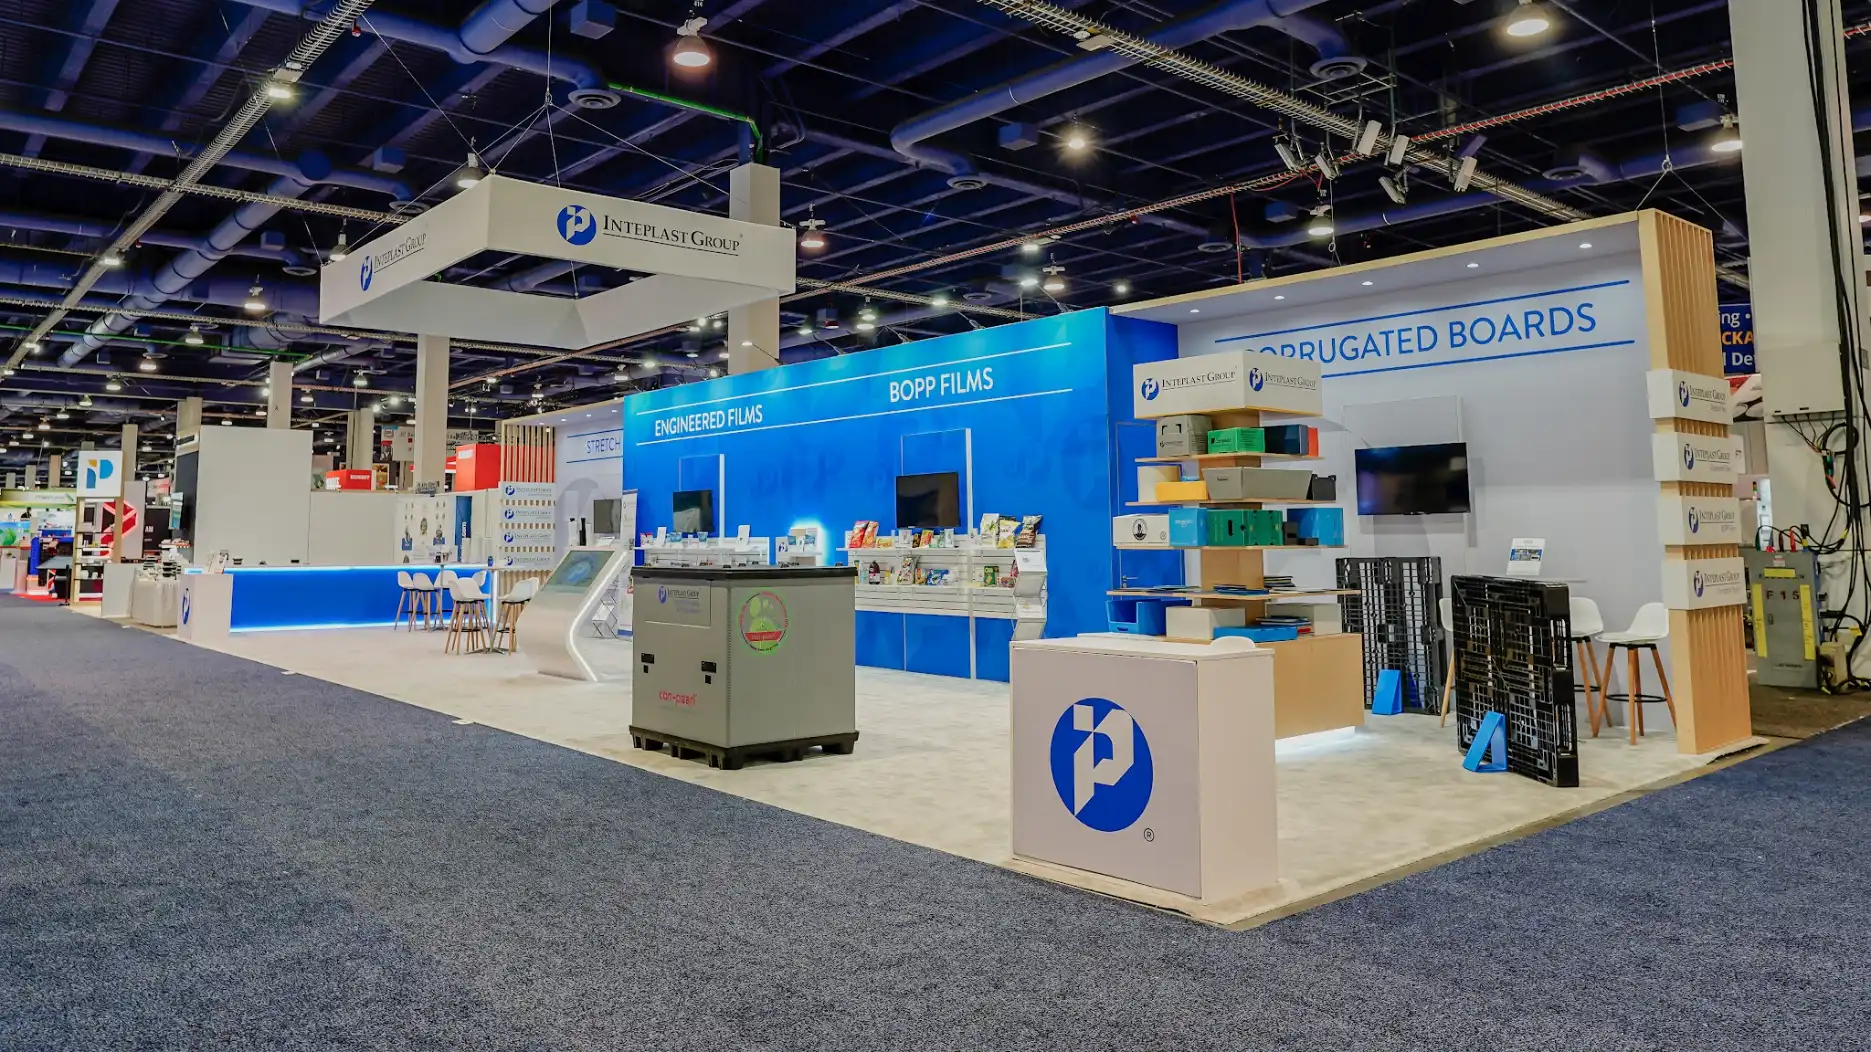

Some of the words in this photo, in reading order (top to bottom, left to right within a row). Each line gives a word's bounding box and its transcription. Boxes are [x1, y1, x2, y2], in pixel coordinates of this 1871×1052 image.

[603, 215, 689, 244] INTEPLAST
[690, 230, 740, 251] GROUP
[374, 243, 405, 269] INTEPLAST
[405, 233, 428, 253] GROUP
[1245, 325, 1438, 364] RRUGATED
[1449, 302, 1597, 349] BOARDS
[889, 376, 936, 403] BOPP
[940, 367, 994, 396] FILMS
[1162, 373, 1206, 388] INTEPLAST
[1207, 371, 1236, 382] GROUP
[1265, 372, 1298, 385] INTEPLAST
[655, 410, 726, 437] ENGINEERED
[727, 404, 763, 427] FILMS
[586, 437, 621, 454] STRETCH
